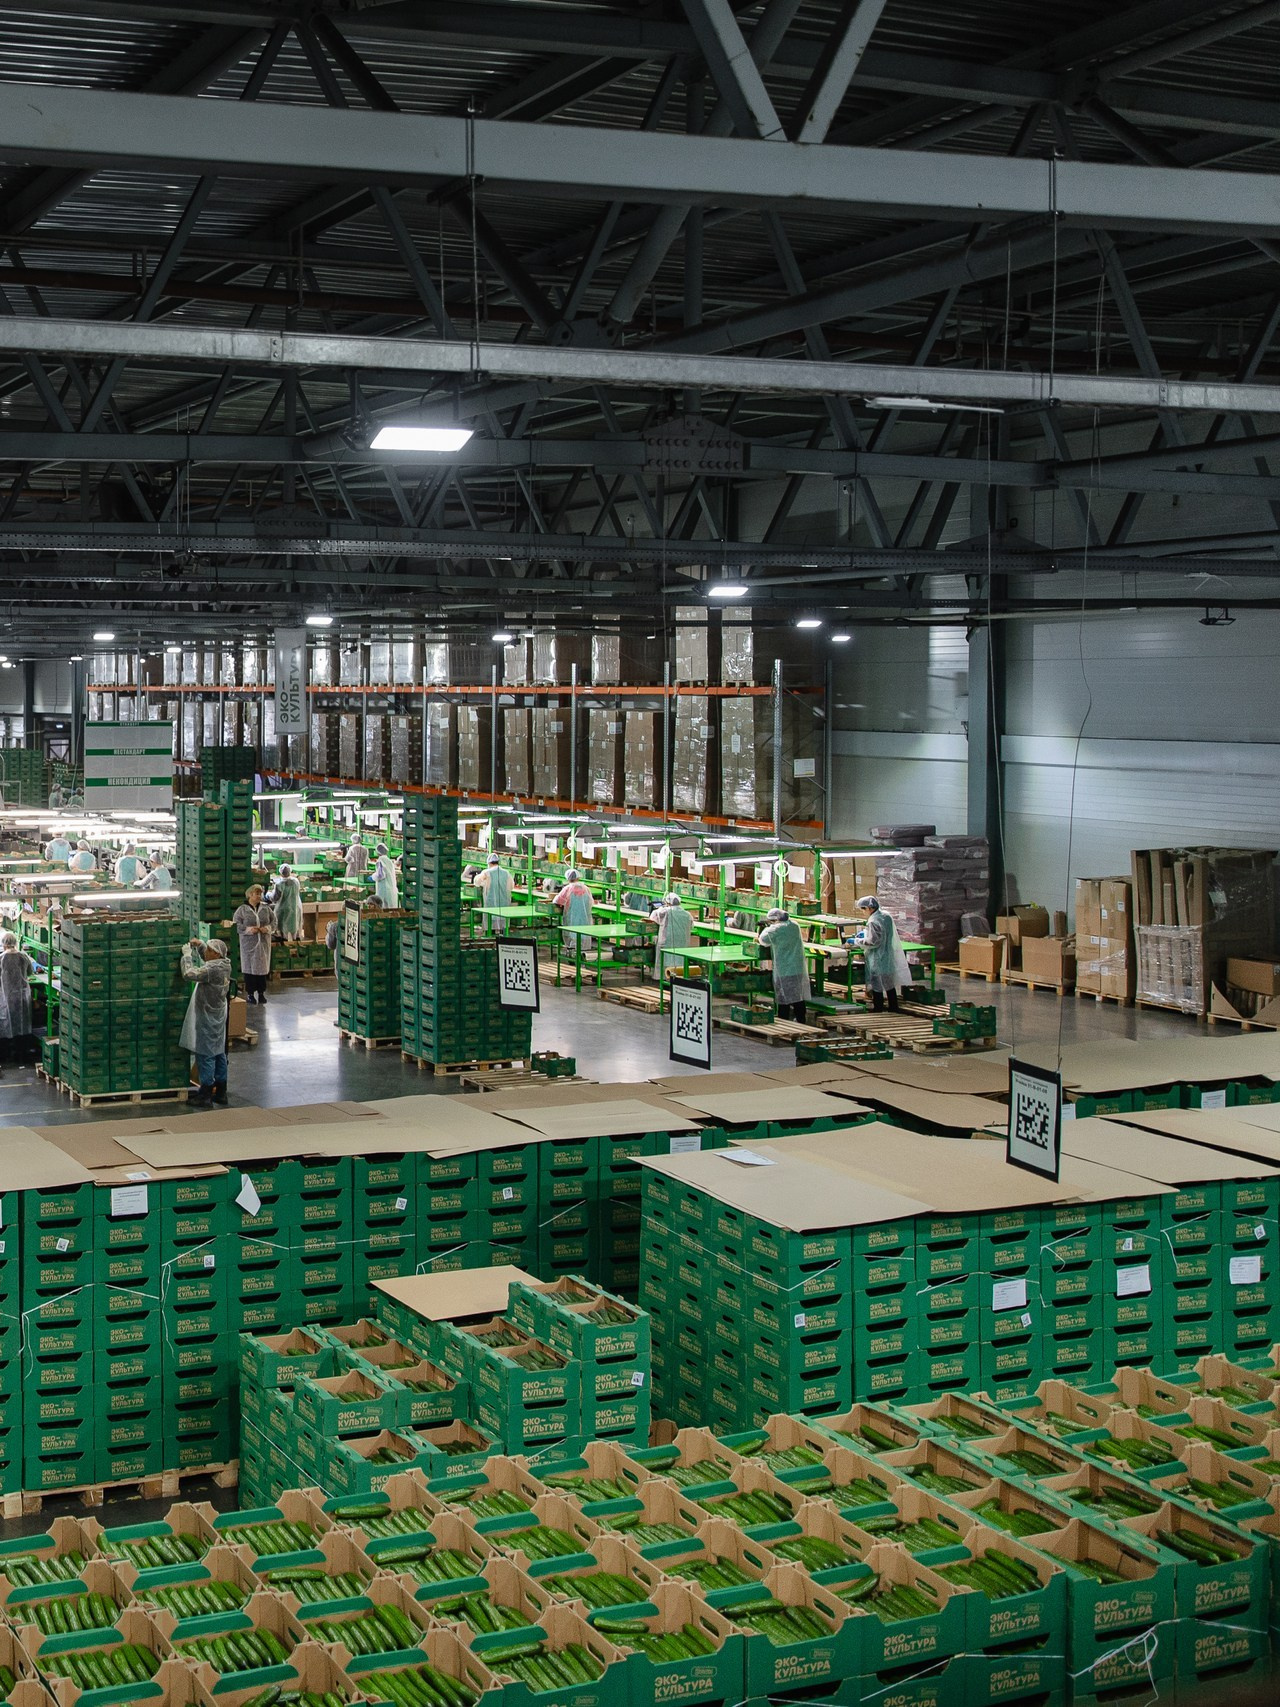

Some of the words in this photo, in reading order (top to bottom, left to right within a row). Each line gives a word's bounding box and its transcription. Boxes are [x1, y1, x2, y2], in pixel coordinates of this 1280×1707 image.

[290, 646, 301, 722] КУЛЬТУРА
[280, 681, 289, 723] ЭКО-
[177, 1191, 209, 1200] КУЛЬТУРА
[431, 1199, 461, 1208] КУЛЬТУРА
[41, 1206, 75, 1215] КУЛЬТУРА
[305, 1209, 335, 1218] КУЛЬТУРА
[110, 1232, 142, 1242] КУЛЬТУРА
[931, 1296, 962, 1306] КУЛЬТУРА
[1177, 1299, 1207, 1308] КУЛЬТУРА
[870, 1305, 901, 1316] КУЛЬТУРА
[1056, 1317, 1086, 1327] КУЛЬТУРА
[595, 1337, 617, 1345] ЭКО-
[595, 1341, 635, 1353] КУЛЬТУРА
[277, 1365, 299, 1374] ЭКО-
[595, 1374, 618, 1383] ЭКО-
[522, 1381, 545, 1390] ЭКО-
[180, 1387, 212, 1396] КУЛЬТУРА
[522, 1386, 564, 1398] КУЛЬТУРА
[112, 1398, 144, 1408] КУЛЬТУРА
[411, 1402, 434, 1410] ЭКО-
[41, 1407, 75, 1416] КУЛЬТУРА
[338, 1412, 361, 1420] ЭКО-
[411, 1407, 452, 1418] КУЛЬТУРА
[595, 1410, 618, 1418] ЭКО-
[338, 1416, 379, 1427] КУЛЬТУРА
[523, 1417, 546, 1426] ЭКО-
[595, 1413, 636, 1426] КУЛЬТУРА
[523, 1422, 564, 1434] КУЛЬТУРА
[447, 1465, 469, 1473] ЭКО-
[1195, 1581, 1226, 1594] ЭКО-
[1195, 1584, 1249, 1606] КУЛЬТУРА
[1094, 1600, 1126, 1613] ЭКО-
[990, 1611, 1018, 1623] ЭКО-
[1094, 1605, 1152, 1624] КУЛЬТУРА
[990, 1614, 1040, 1632] КУЛЬТУРА
[884, 1634, 913, 1646] ЭКО-
[1195, 1635, 1225, 1649] ЭКО-
[884, 1637, 936, 1657] КУЛЬТУРА
[1195, 1639, 1249, 1661] КУЛЬТУРА
[775, 1656, 805, 1668] ЭКО-
[775, 1660, 831, 1679] КУЛЬТУРА
[654, 1674, 687, 1687] ЭКО-
[990, 1670, 1017, 1682] ЭКО-
[990, 1673, 1040, 1691] КУЛЬТУРА
[654, 1678, 713, 1698] КУЛЬТУРА
[884, 1695, 913, 1706] ЭКО-
